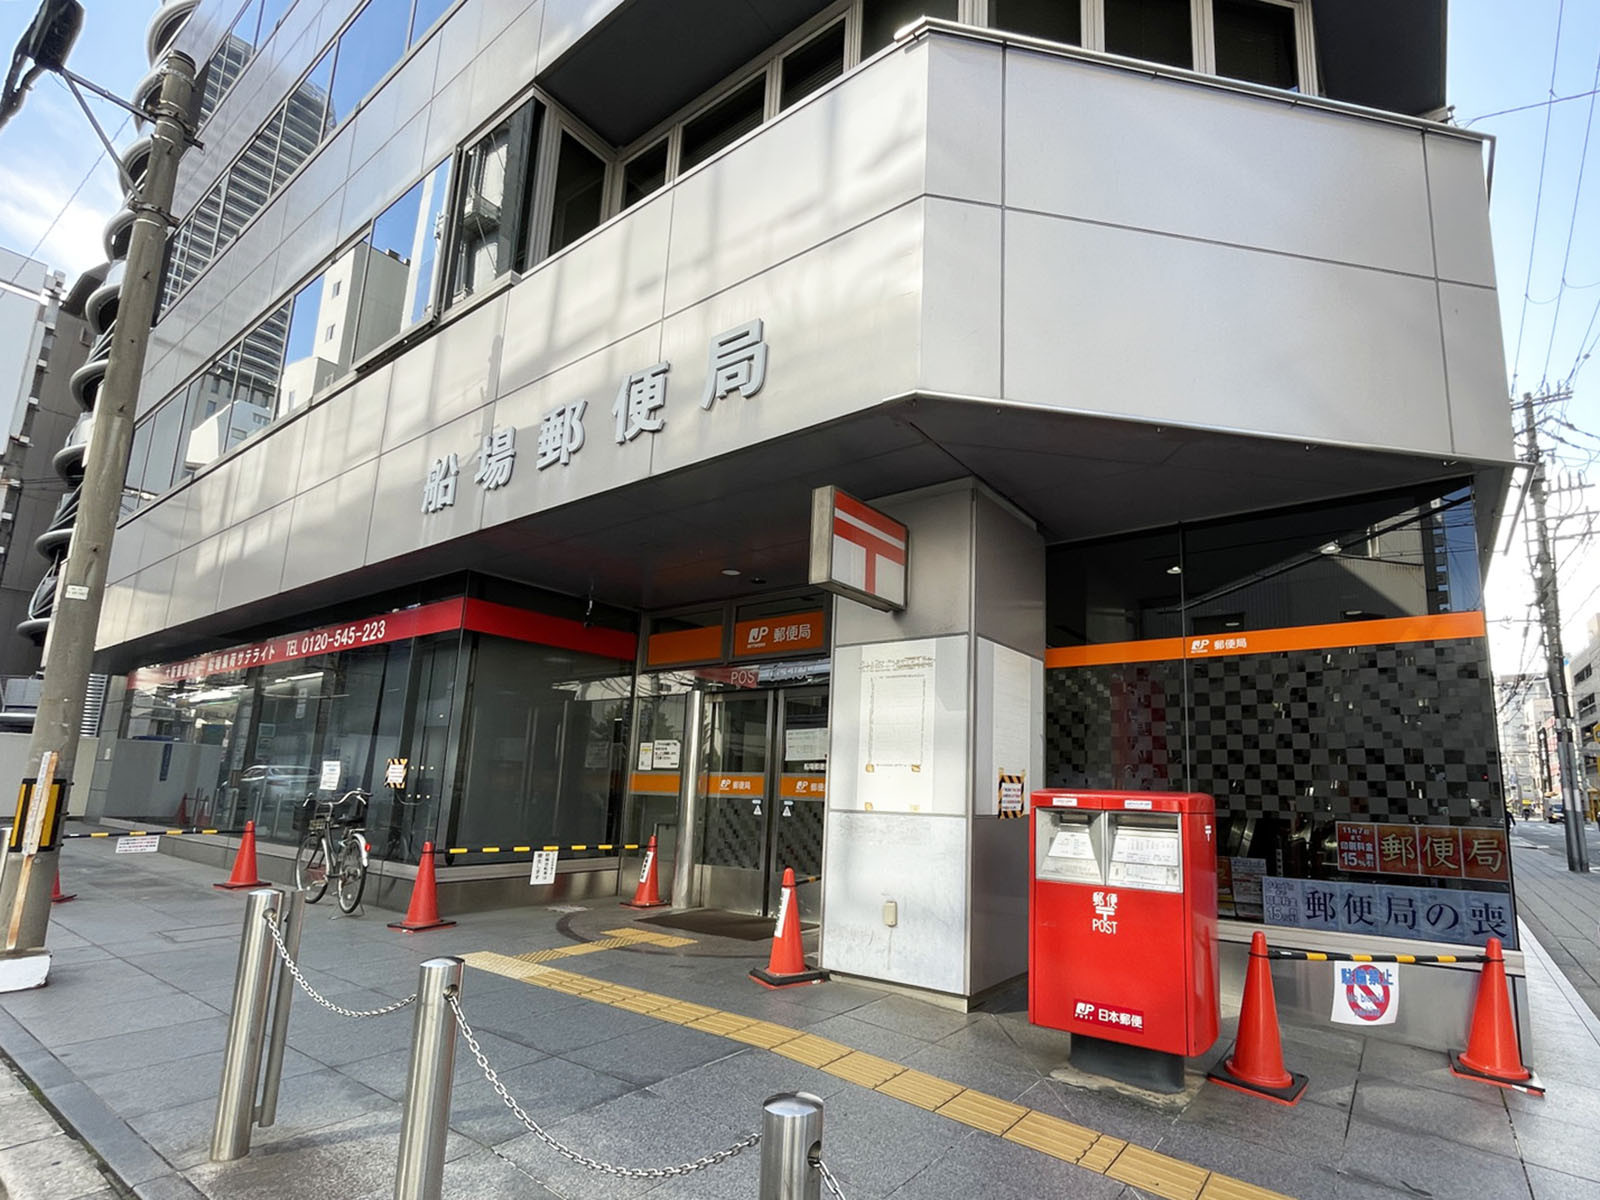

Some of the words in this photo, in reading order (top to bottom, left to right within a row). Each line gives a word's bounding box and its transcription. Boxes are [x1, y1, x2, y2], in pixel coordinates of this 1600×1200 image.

[421, 317, 768, 514] 船場郵便局
[286, 639, 298, 656] TEL
[301, 619, 386, 654] 0120-545-223
[773, 623, 811, 643] 郵便局
[1214, 637, 1247, 650] 郵便局
[1381, 832, 1503, 873] 郵便局
[1092, 891, 1118, 908] 郵便
[1305, 889, 1508, 938] 郵便局の喪
[1092, 918, 1118, 935] POST
[1098, 1008, 1143, 1029] 日本郵便
